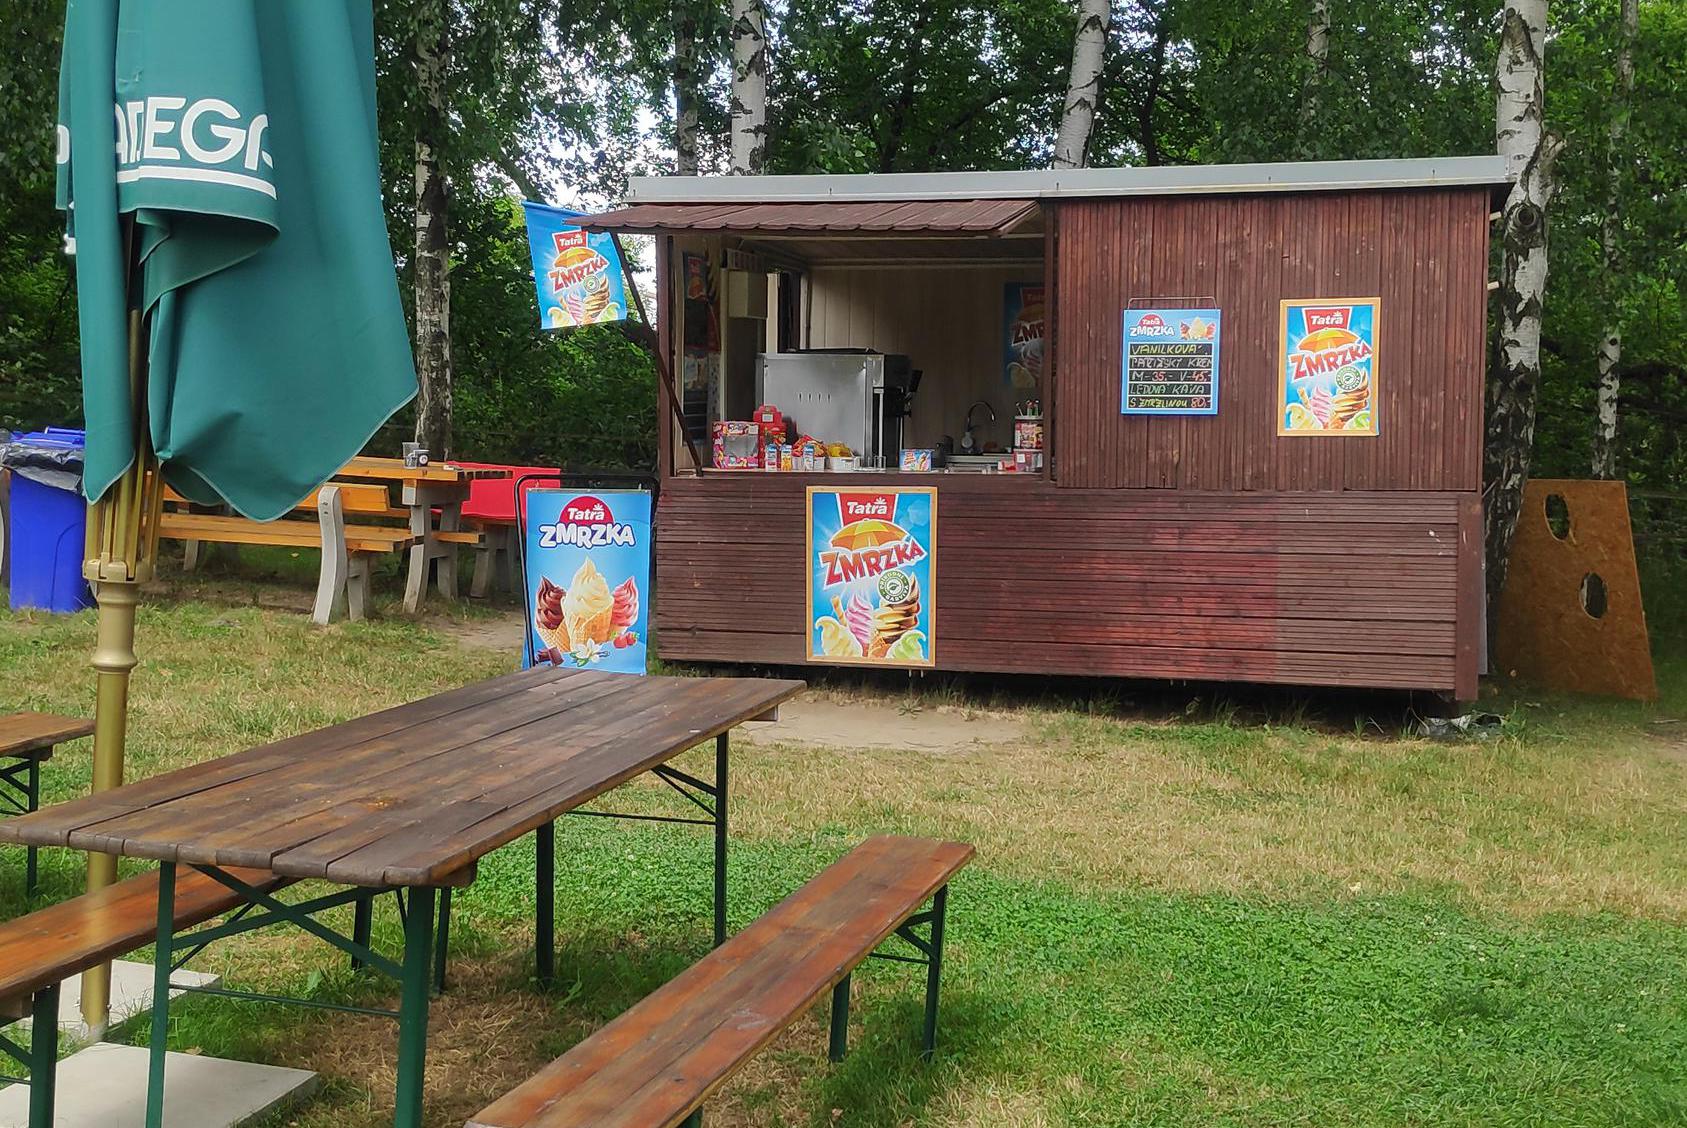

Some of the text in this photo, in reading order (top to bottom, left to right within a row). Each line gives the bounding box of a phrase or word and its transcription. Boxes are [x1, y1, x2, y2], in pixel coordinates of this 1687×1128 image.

[548, 256, 609, 291] ZMRZKA
[1310, 315, 1344, 325] Tatra
[1129, 325, 1175, 337] ZMRZKA
[1289, 343, 1373, 380] ZMRZKA
[1129, 397, 1137, 407] S
[567, 507, 605, 521] Tatra
[847, 500, 888, 515] Tatra
[540, 523, 635, 549] ZMRZKA
[820, 538, 926, 586] ZMRZKA
